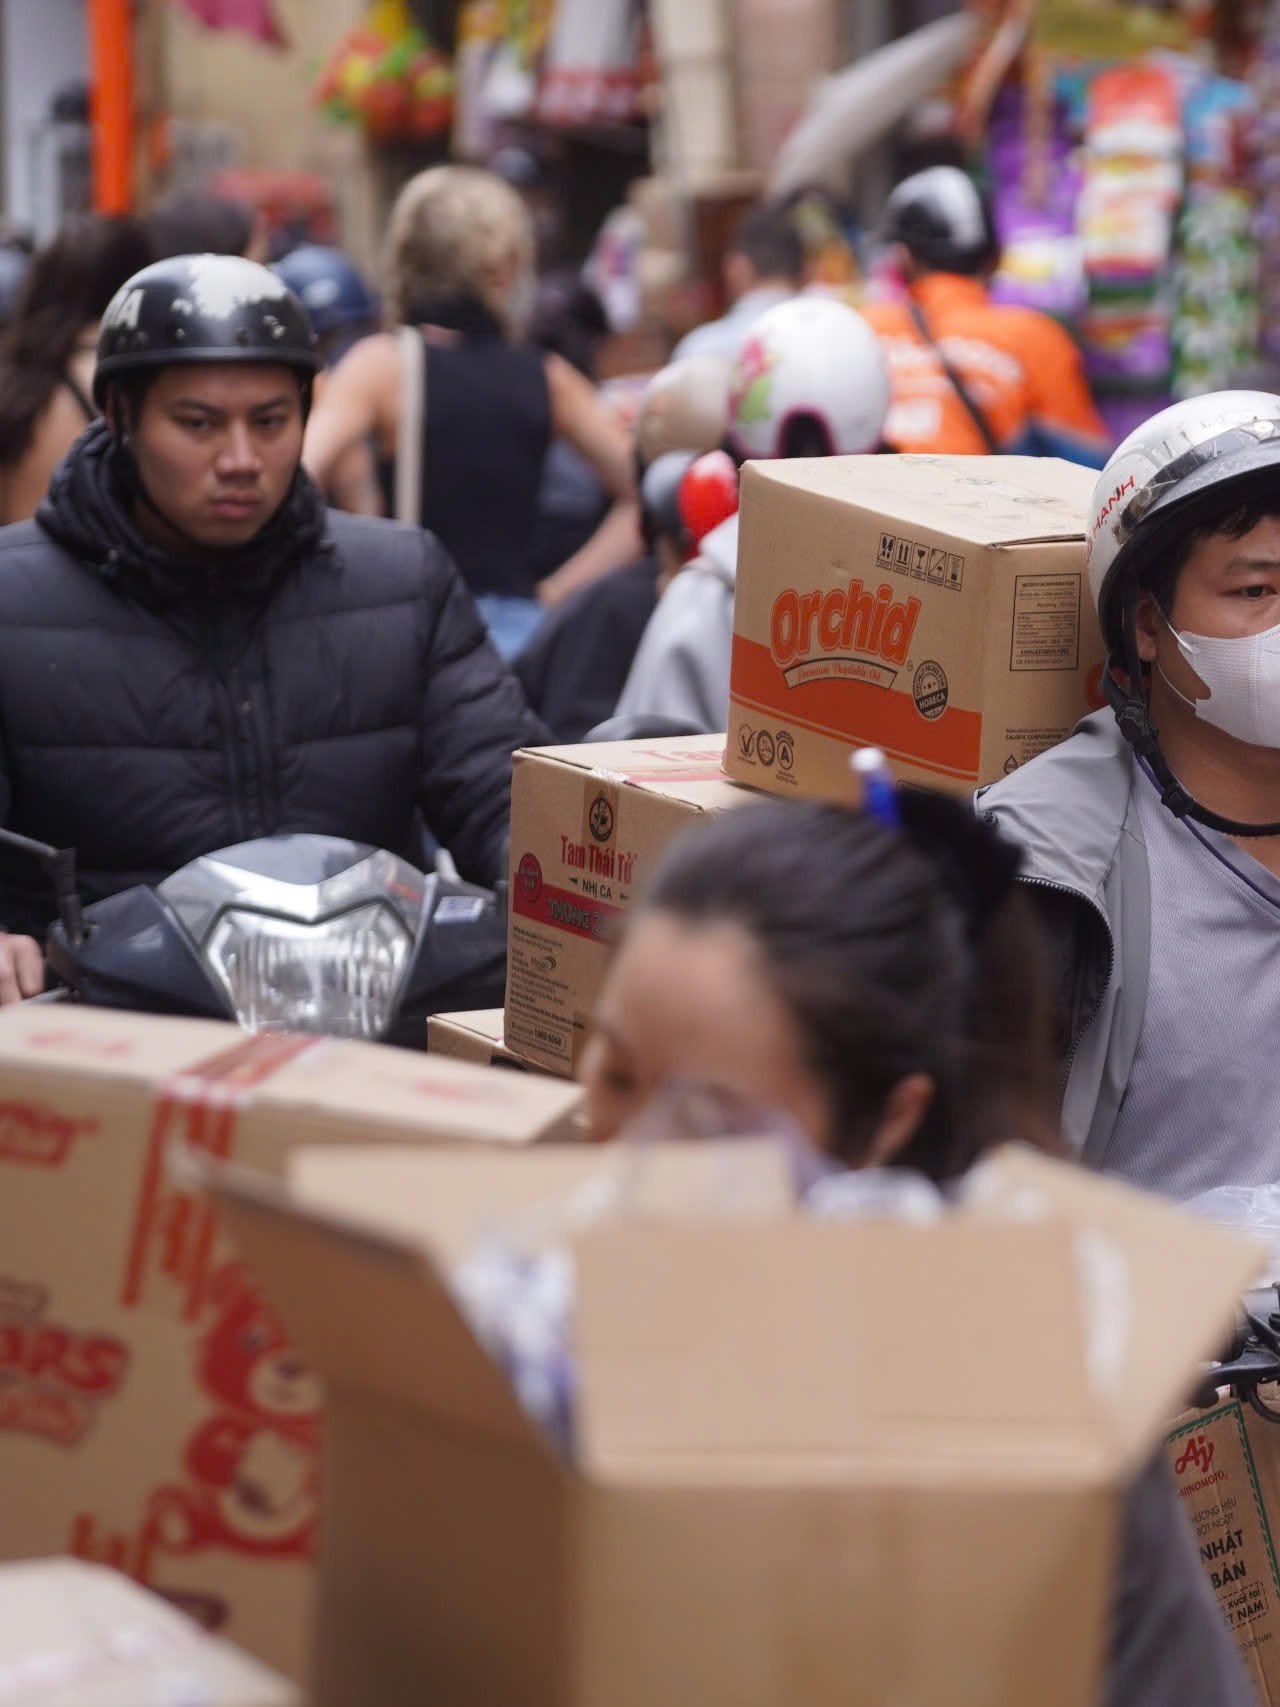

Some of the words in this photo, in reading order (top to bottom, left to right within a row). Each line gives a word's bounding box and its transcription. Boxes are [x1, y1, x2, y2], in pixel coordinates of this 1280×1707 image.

[919, 692, 946, 710] HORECA
[560, 834, 586, 869] Tam
[588, 843, 615, 879] Thái
[582, 879, 598, 898] NHỊ
[600, 884, 612, 900] CA
[1200, 1529, 1243, 1561] NHẬT
[1210, 1559, 1247, 1590] BẢN
[1237, 1601, 1264, 1620] NAM
